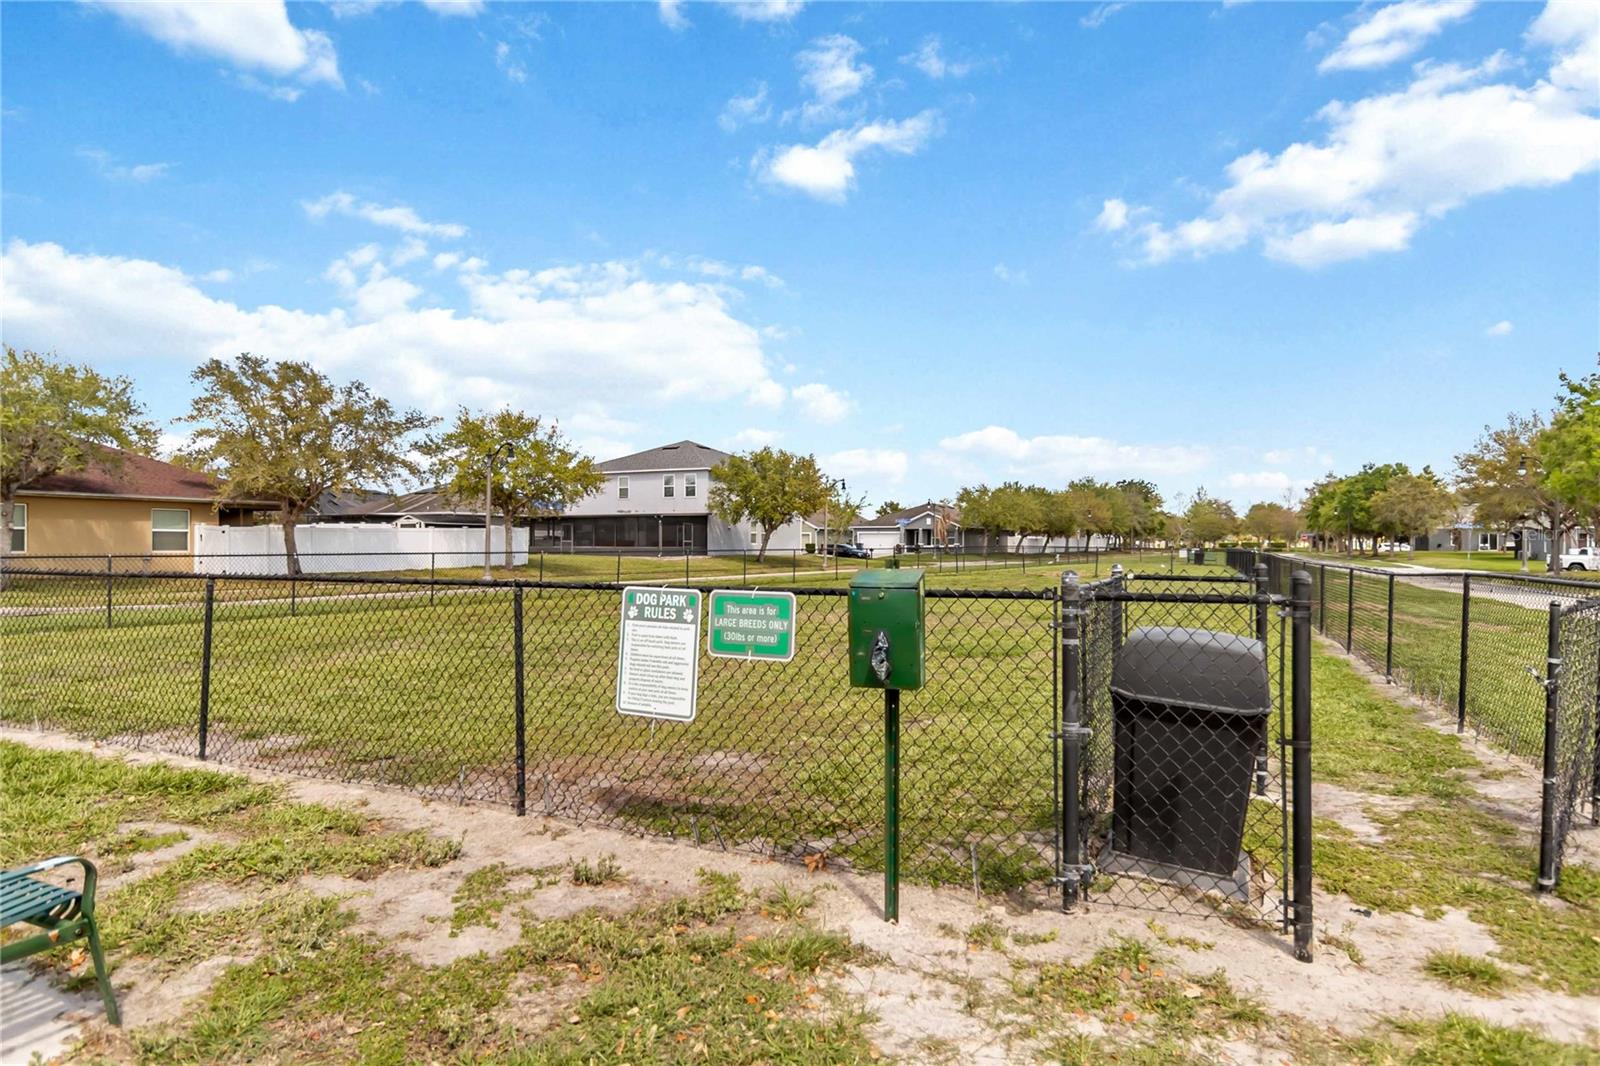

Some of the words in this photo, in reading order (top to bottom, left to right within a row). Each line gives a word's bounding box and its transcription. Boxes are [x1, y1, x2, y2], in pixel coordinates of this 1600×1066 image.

[635, 593, 658, 605] DOG
[659, 594, 687, 607] PARK
[644, 606, 677, 620] RULES
[727, 604, 740, 614] This
[741, 607, 757, 615] area
[758, 605, 765, 615] is
[766, 606, 777, 616] for
[714, 617, 737, 627] LARGE
[738, 618, 767, 629] BREEDS
[768, 620, 789, 631] ONLY
[723, 631, 745, 641] (30lbs
[746, 634, 755, 642] or
[756, 634, 778, 644] more)
